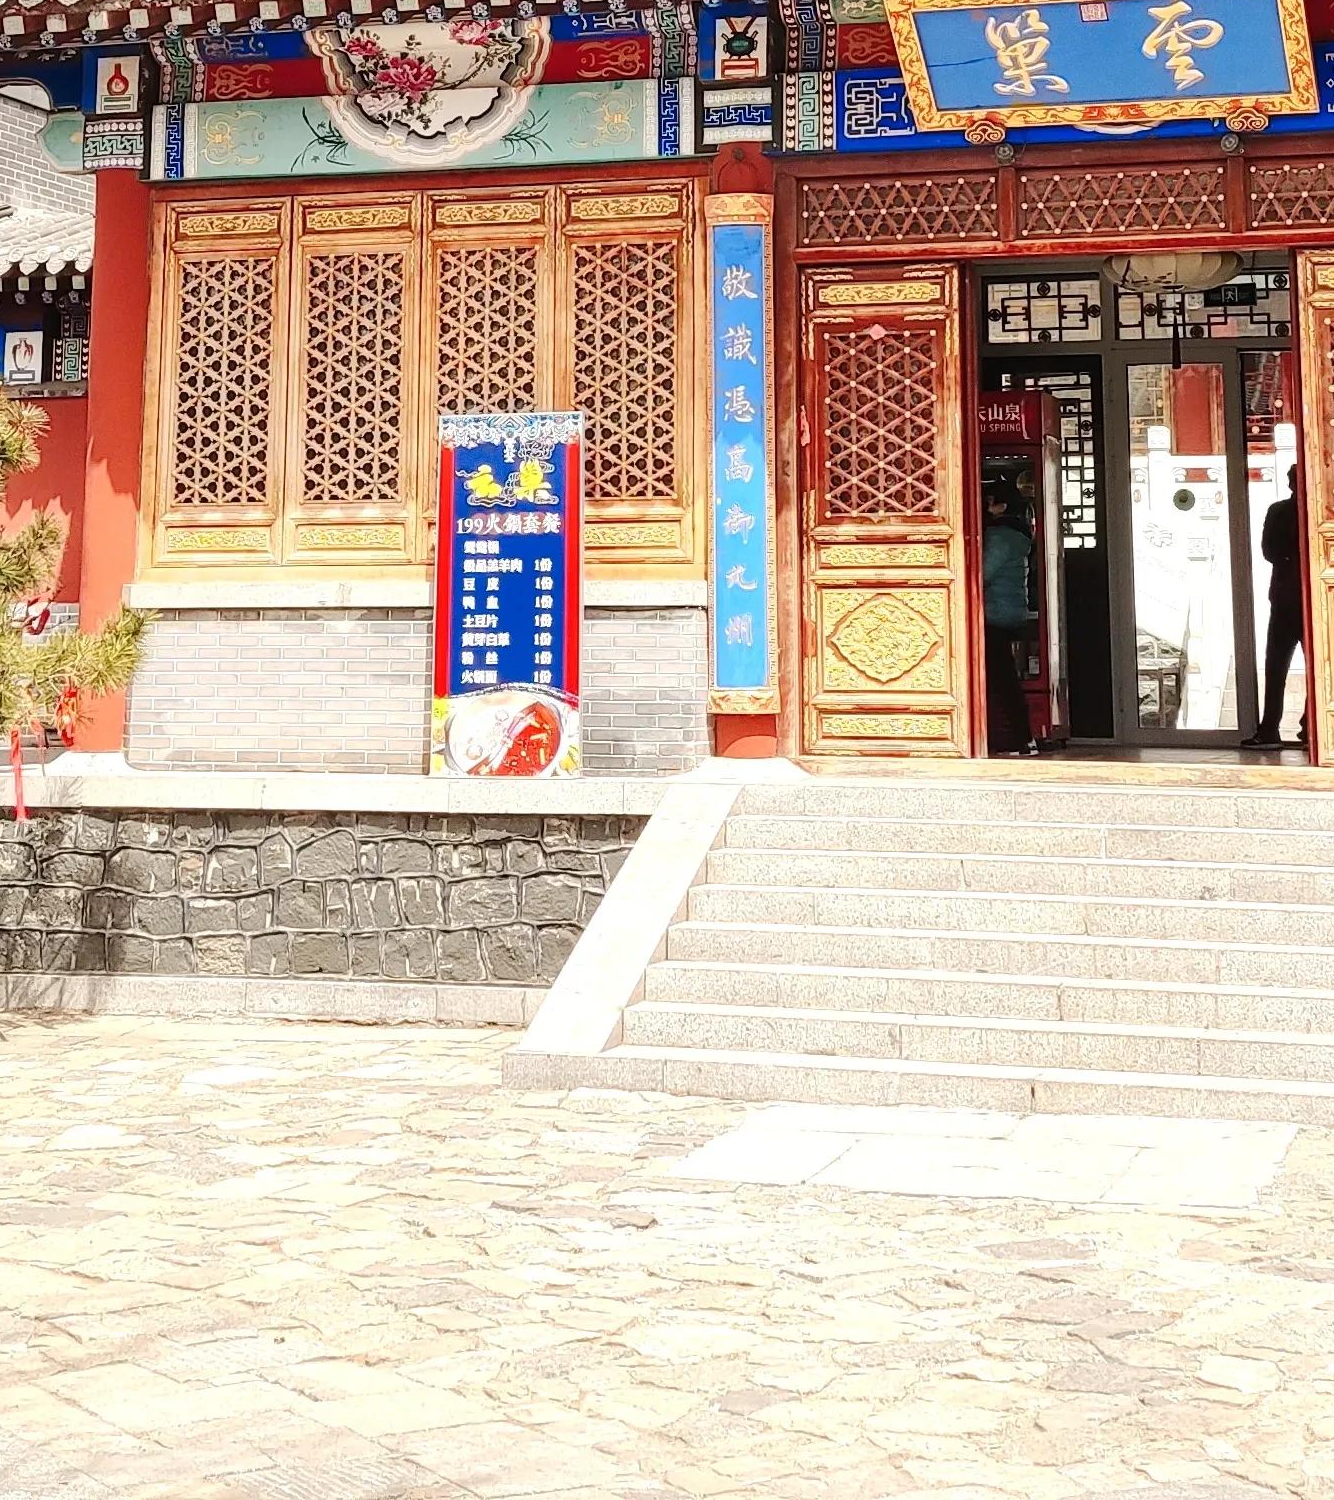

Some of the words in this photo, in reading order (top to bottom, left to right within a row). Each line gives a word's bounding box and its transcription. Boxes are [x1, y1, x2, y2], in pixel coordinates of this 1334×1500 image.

[989, 423, 1021, 432] SPRING
[462, 613, 499, 628] 土豆片
